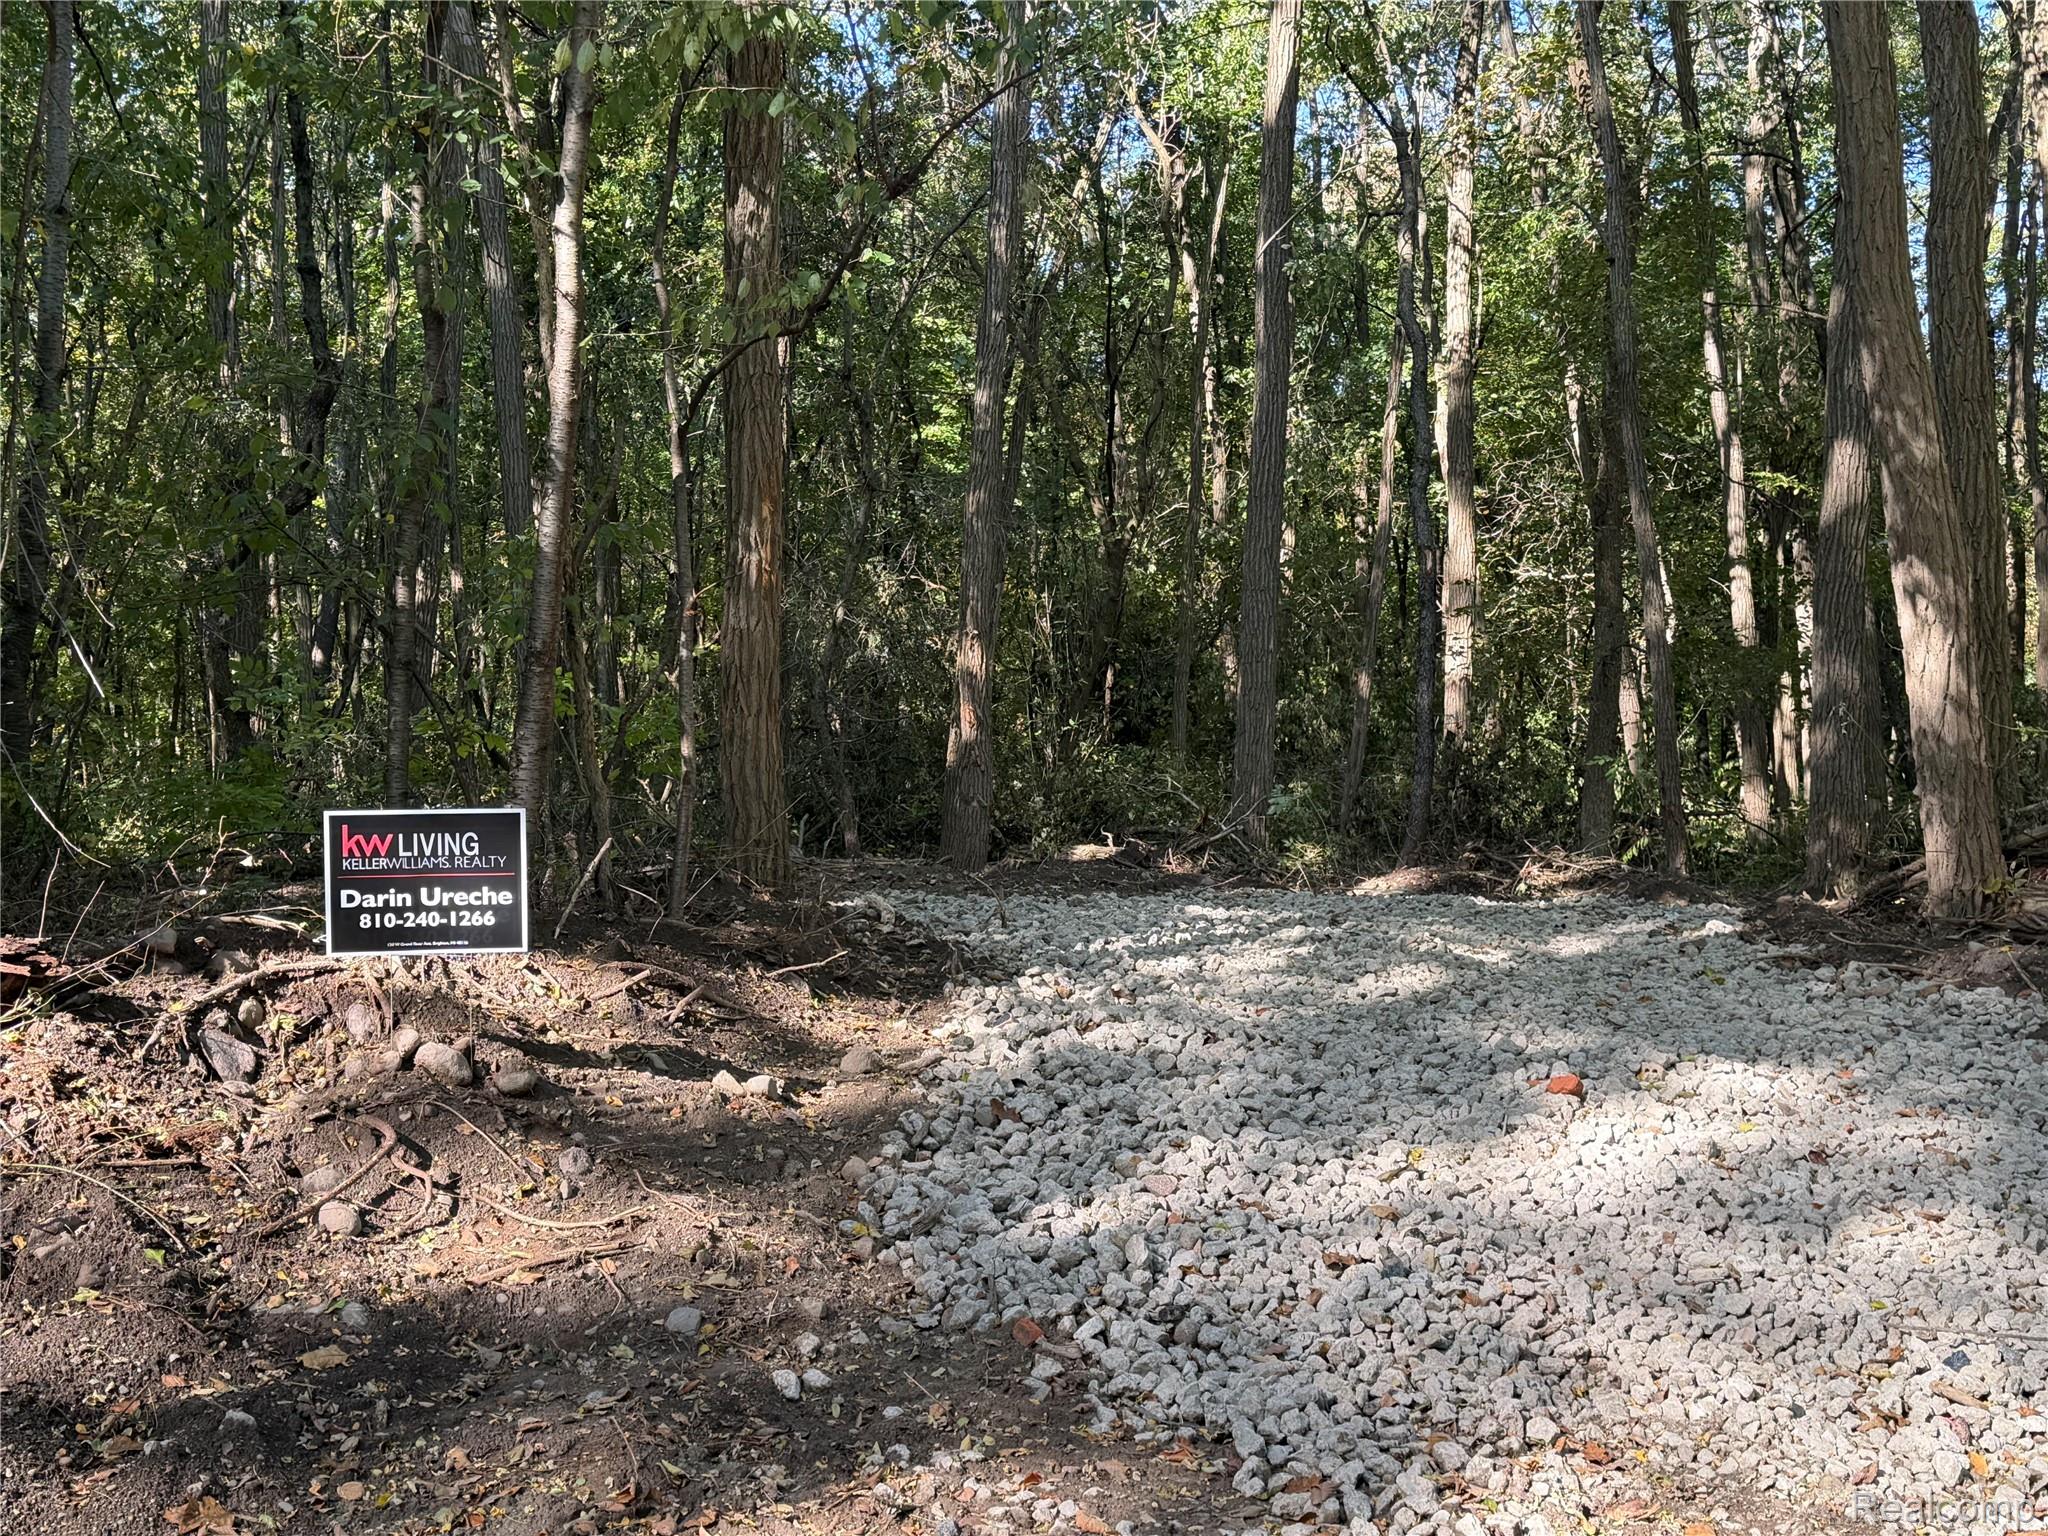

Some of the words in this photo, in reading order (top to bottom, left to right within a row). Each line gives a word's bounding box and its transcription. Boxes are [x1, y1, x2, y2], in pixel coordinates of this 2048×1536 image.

[341, 824, 394, 857] kw
[398, 832, 480, 857] LIVING
[454, 855, 507, 869] REALTY
[340, 888, 412, 909] Darin
[420, 886, 513, 907] Ureche
[359, 911, 496, 929] 810-240-1266
